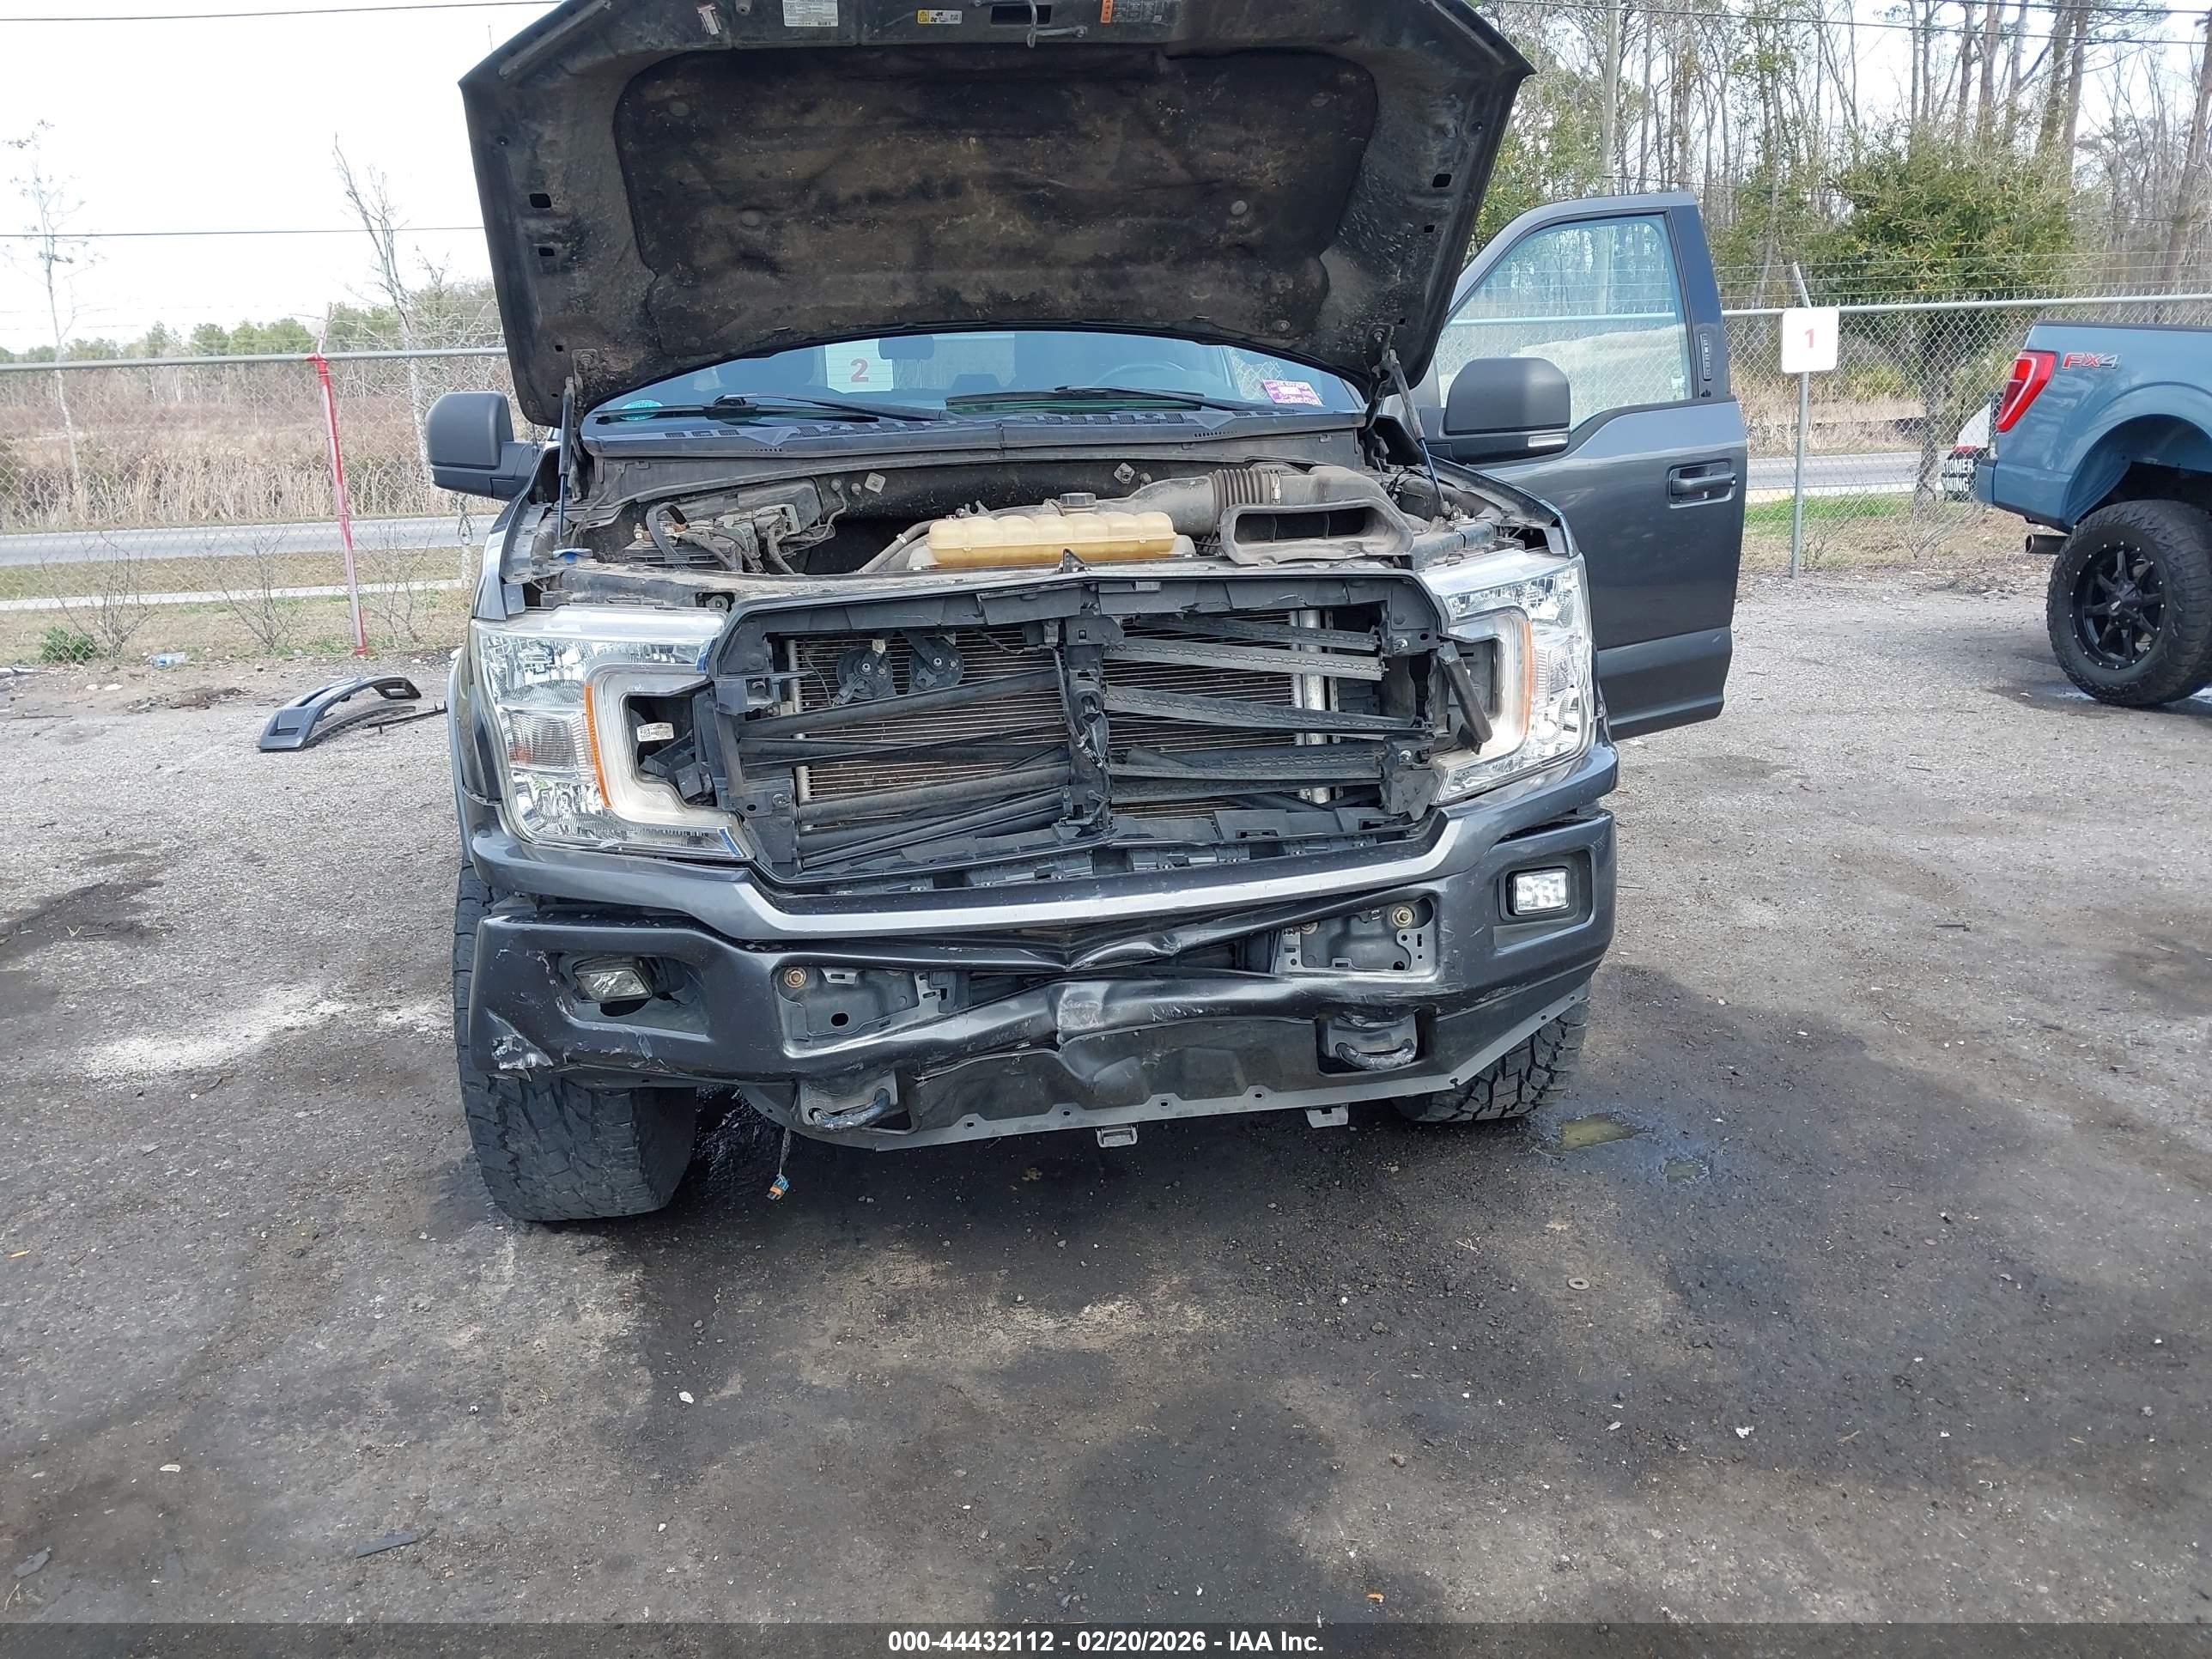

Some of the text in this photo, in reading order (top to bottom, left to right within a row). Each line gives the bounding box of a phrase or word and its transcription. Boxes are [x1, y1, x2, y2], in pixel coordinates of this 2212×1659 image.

[1805, 328, 1814, 348] 1
[851, 358, 869, 383] 2
[2062, 352, 2118, 370] FX4
